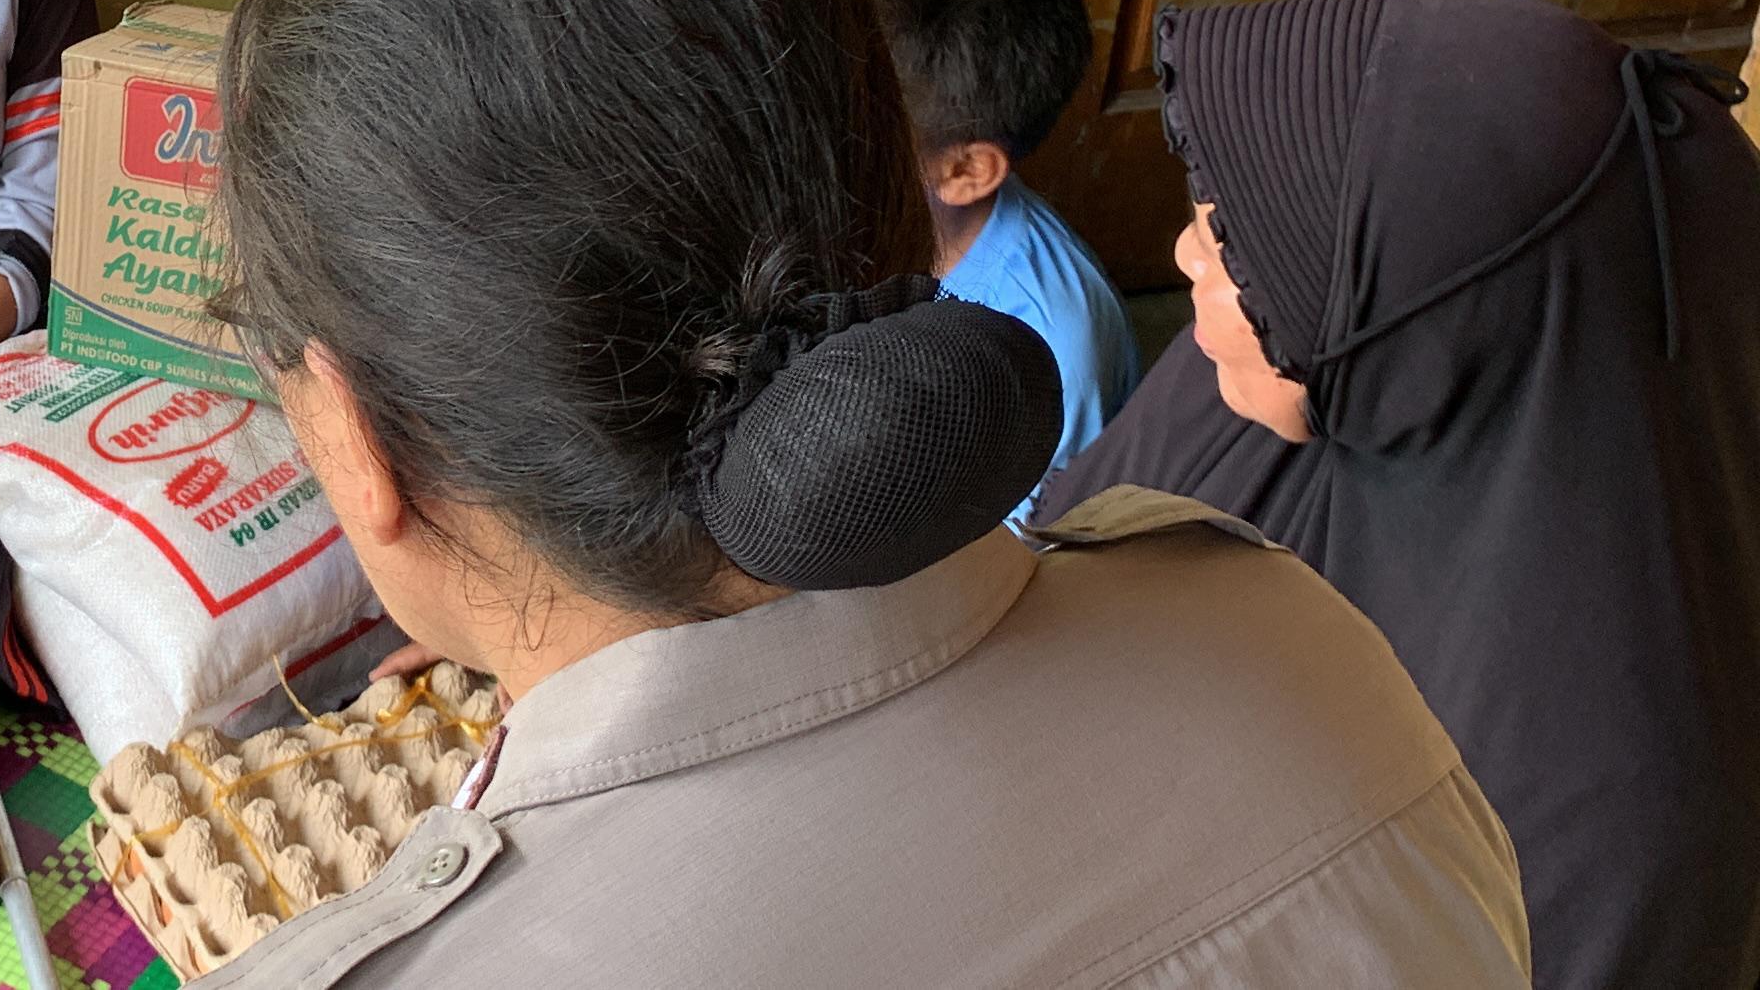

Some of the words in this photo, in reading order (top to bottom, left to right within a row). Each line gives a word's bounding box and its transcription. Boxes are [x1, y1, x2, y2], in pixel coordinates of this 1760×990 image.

[107, 185, 207, 223] Rasa
[105, 214, 225, 264] Kaldu
[102, 251, 225, 300] Ayam
[100, 292, 145, 311] CHICKEN
[145, 300, 174, 315] SOUP
[60, 341, 74, 355] PT
[76, 344, 138, 367] INDOFOOD
[139, 359, 162, 372] CBP
[166, 363, 207, 383] SUKSES
[175, 463, 219, 503] BARU
[194, 460, 300, 532] SUKARAYA
[228, 521, 256, 548] 64
[253, 506, 281, 531] IR
